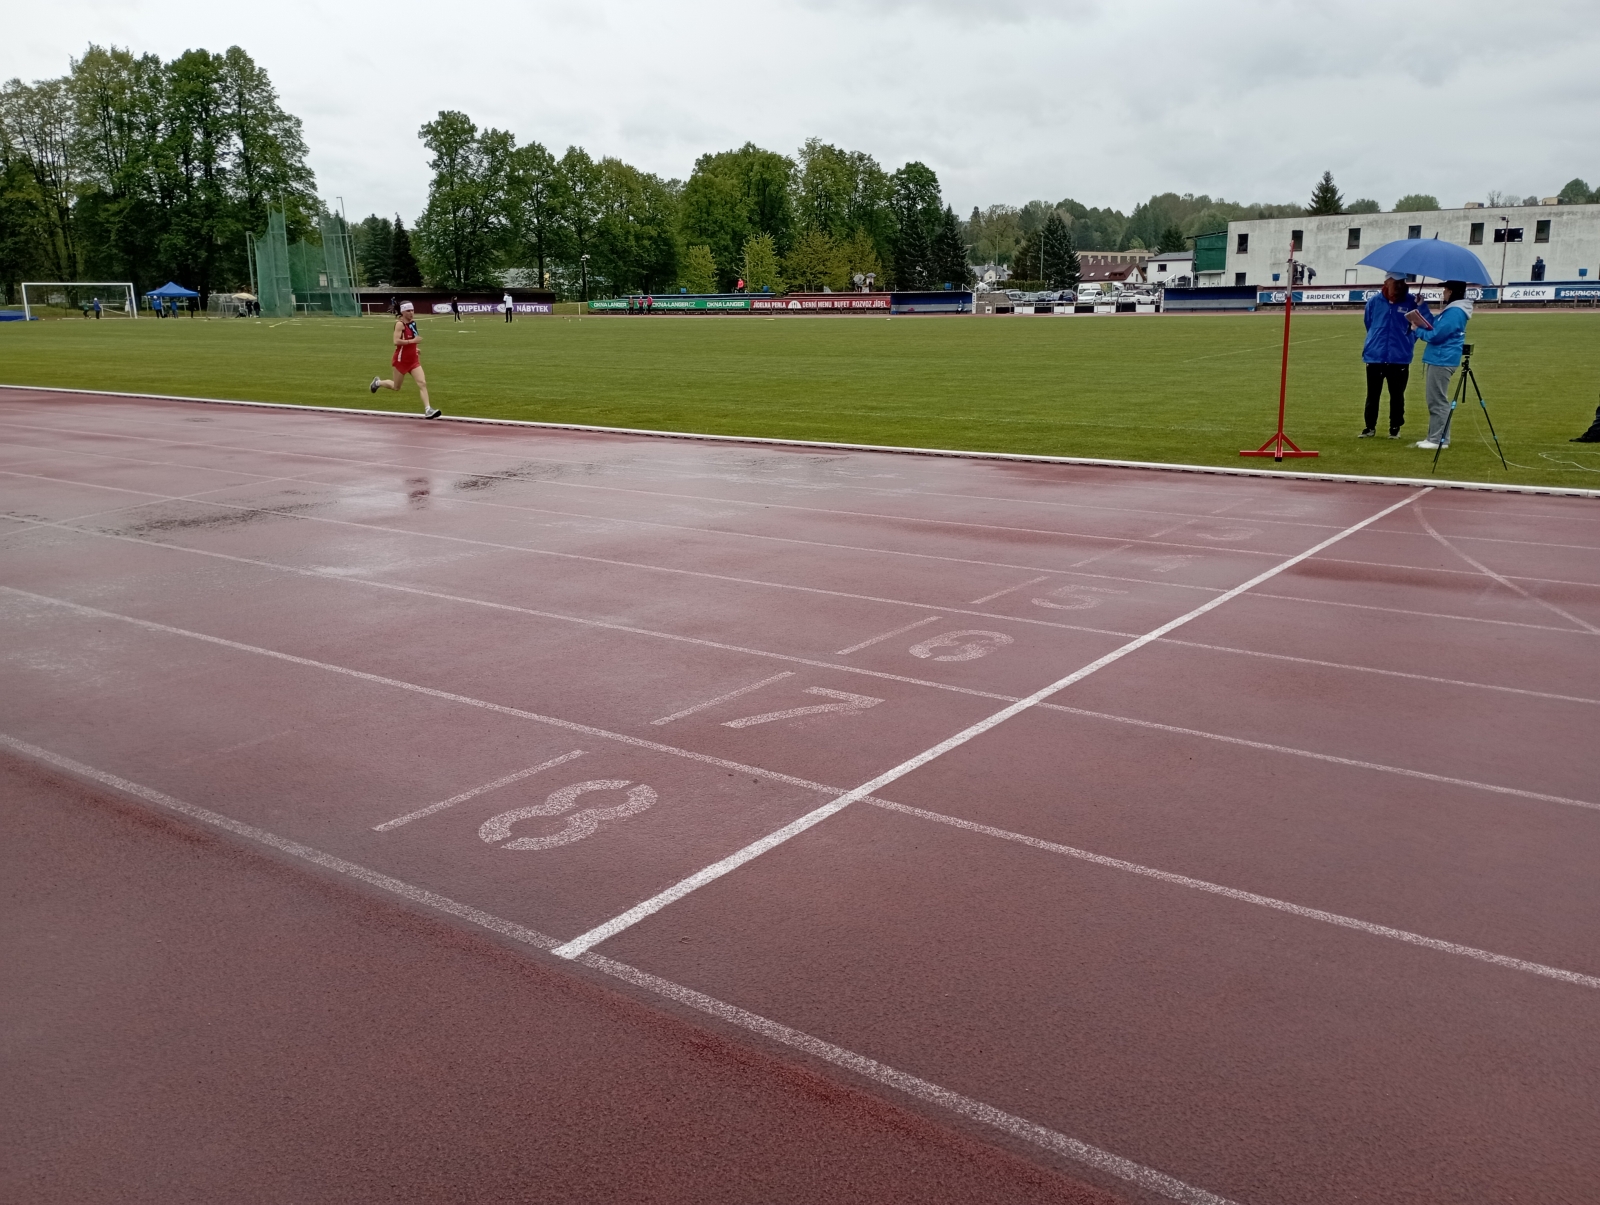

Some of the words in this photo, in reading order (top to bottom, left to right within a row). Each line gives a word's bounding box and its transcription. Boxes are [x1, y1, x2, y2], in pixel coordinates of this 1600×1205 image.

[454, 304, 491, 312] OUPELNY
[517, 304, 549, 312] NÁBYTEK
[1031, 584, 1129, 610] 5
[908, 629, 1015, 662] 6
[720, 686, 886, 729] 7
[478, 779, 658, 850] 8
